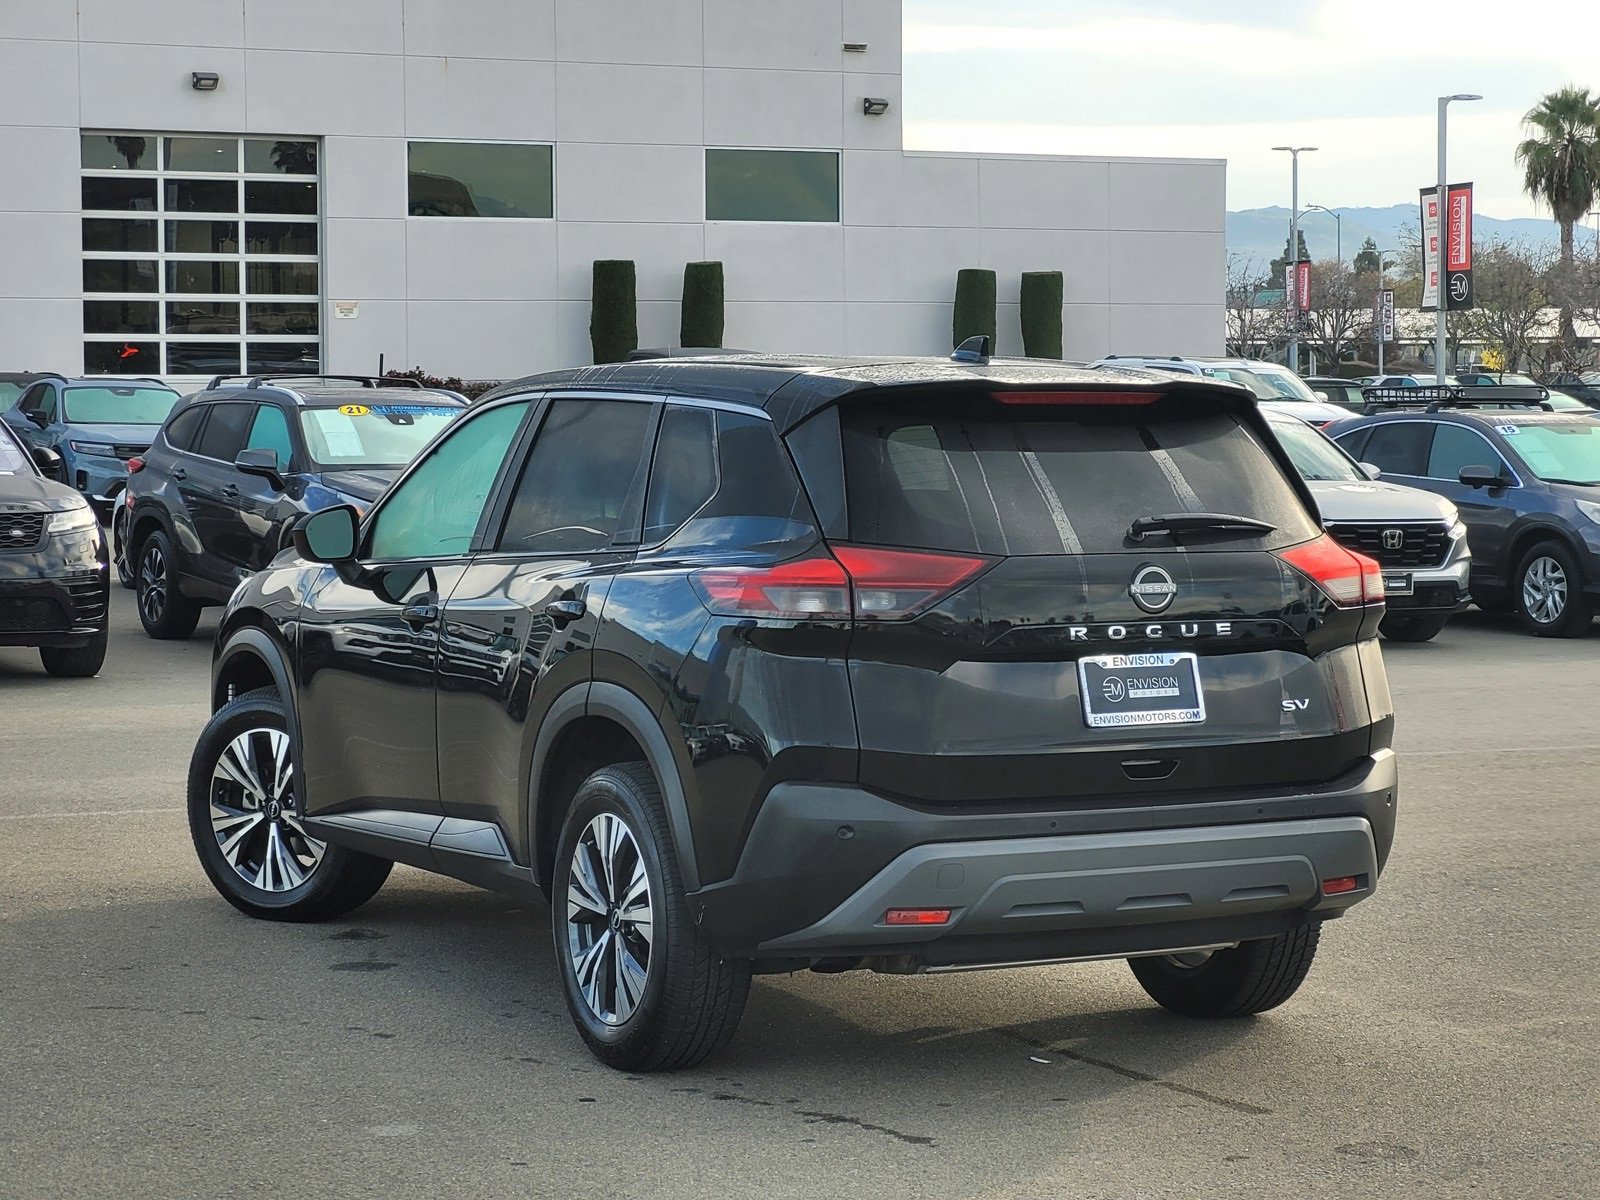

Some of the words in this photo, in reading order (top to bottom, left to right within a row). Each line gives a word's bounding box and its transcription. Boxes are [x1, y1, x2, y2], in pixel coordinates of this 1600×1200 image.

[1451, 196, 1461, 265] ENVISION
[346, 406, 362, 414] 21
[1501, 425, 1516, 434] 15
[1131, 584, 1177, 593] NISSAN
[1069, 622, 1232, 641] ROGUE
[1112, 655, 1165, 667] ENVISION
[1126, 676, 1179, 690] ENVISION
[1281, 698, 1310, 712] SV
[1093, 710, 1201, 725] ENVISIONMOTORS.COM
